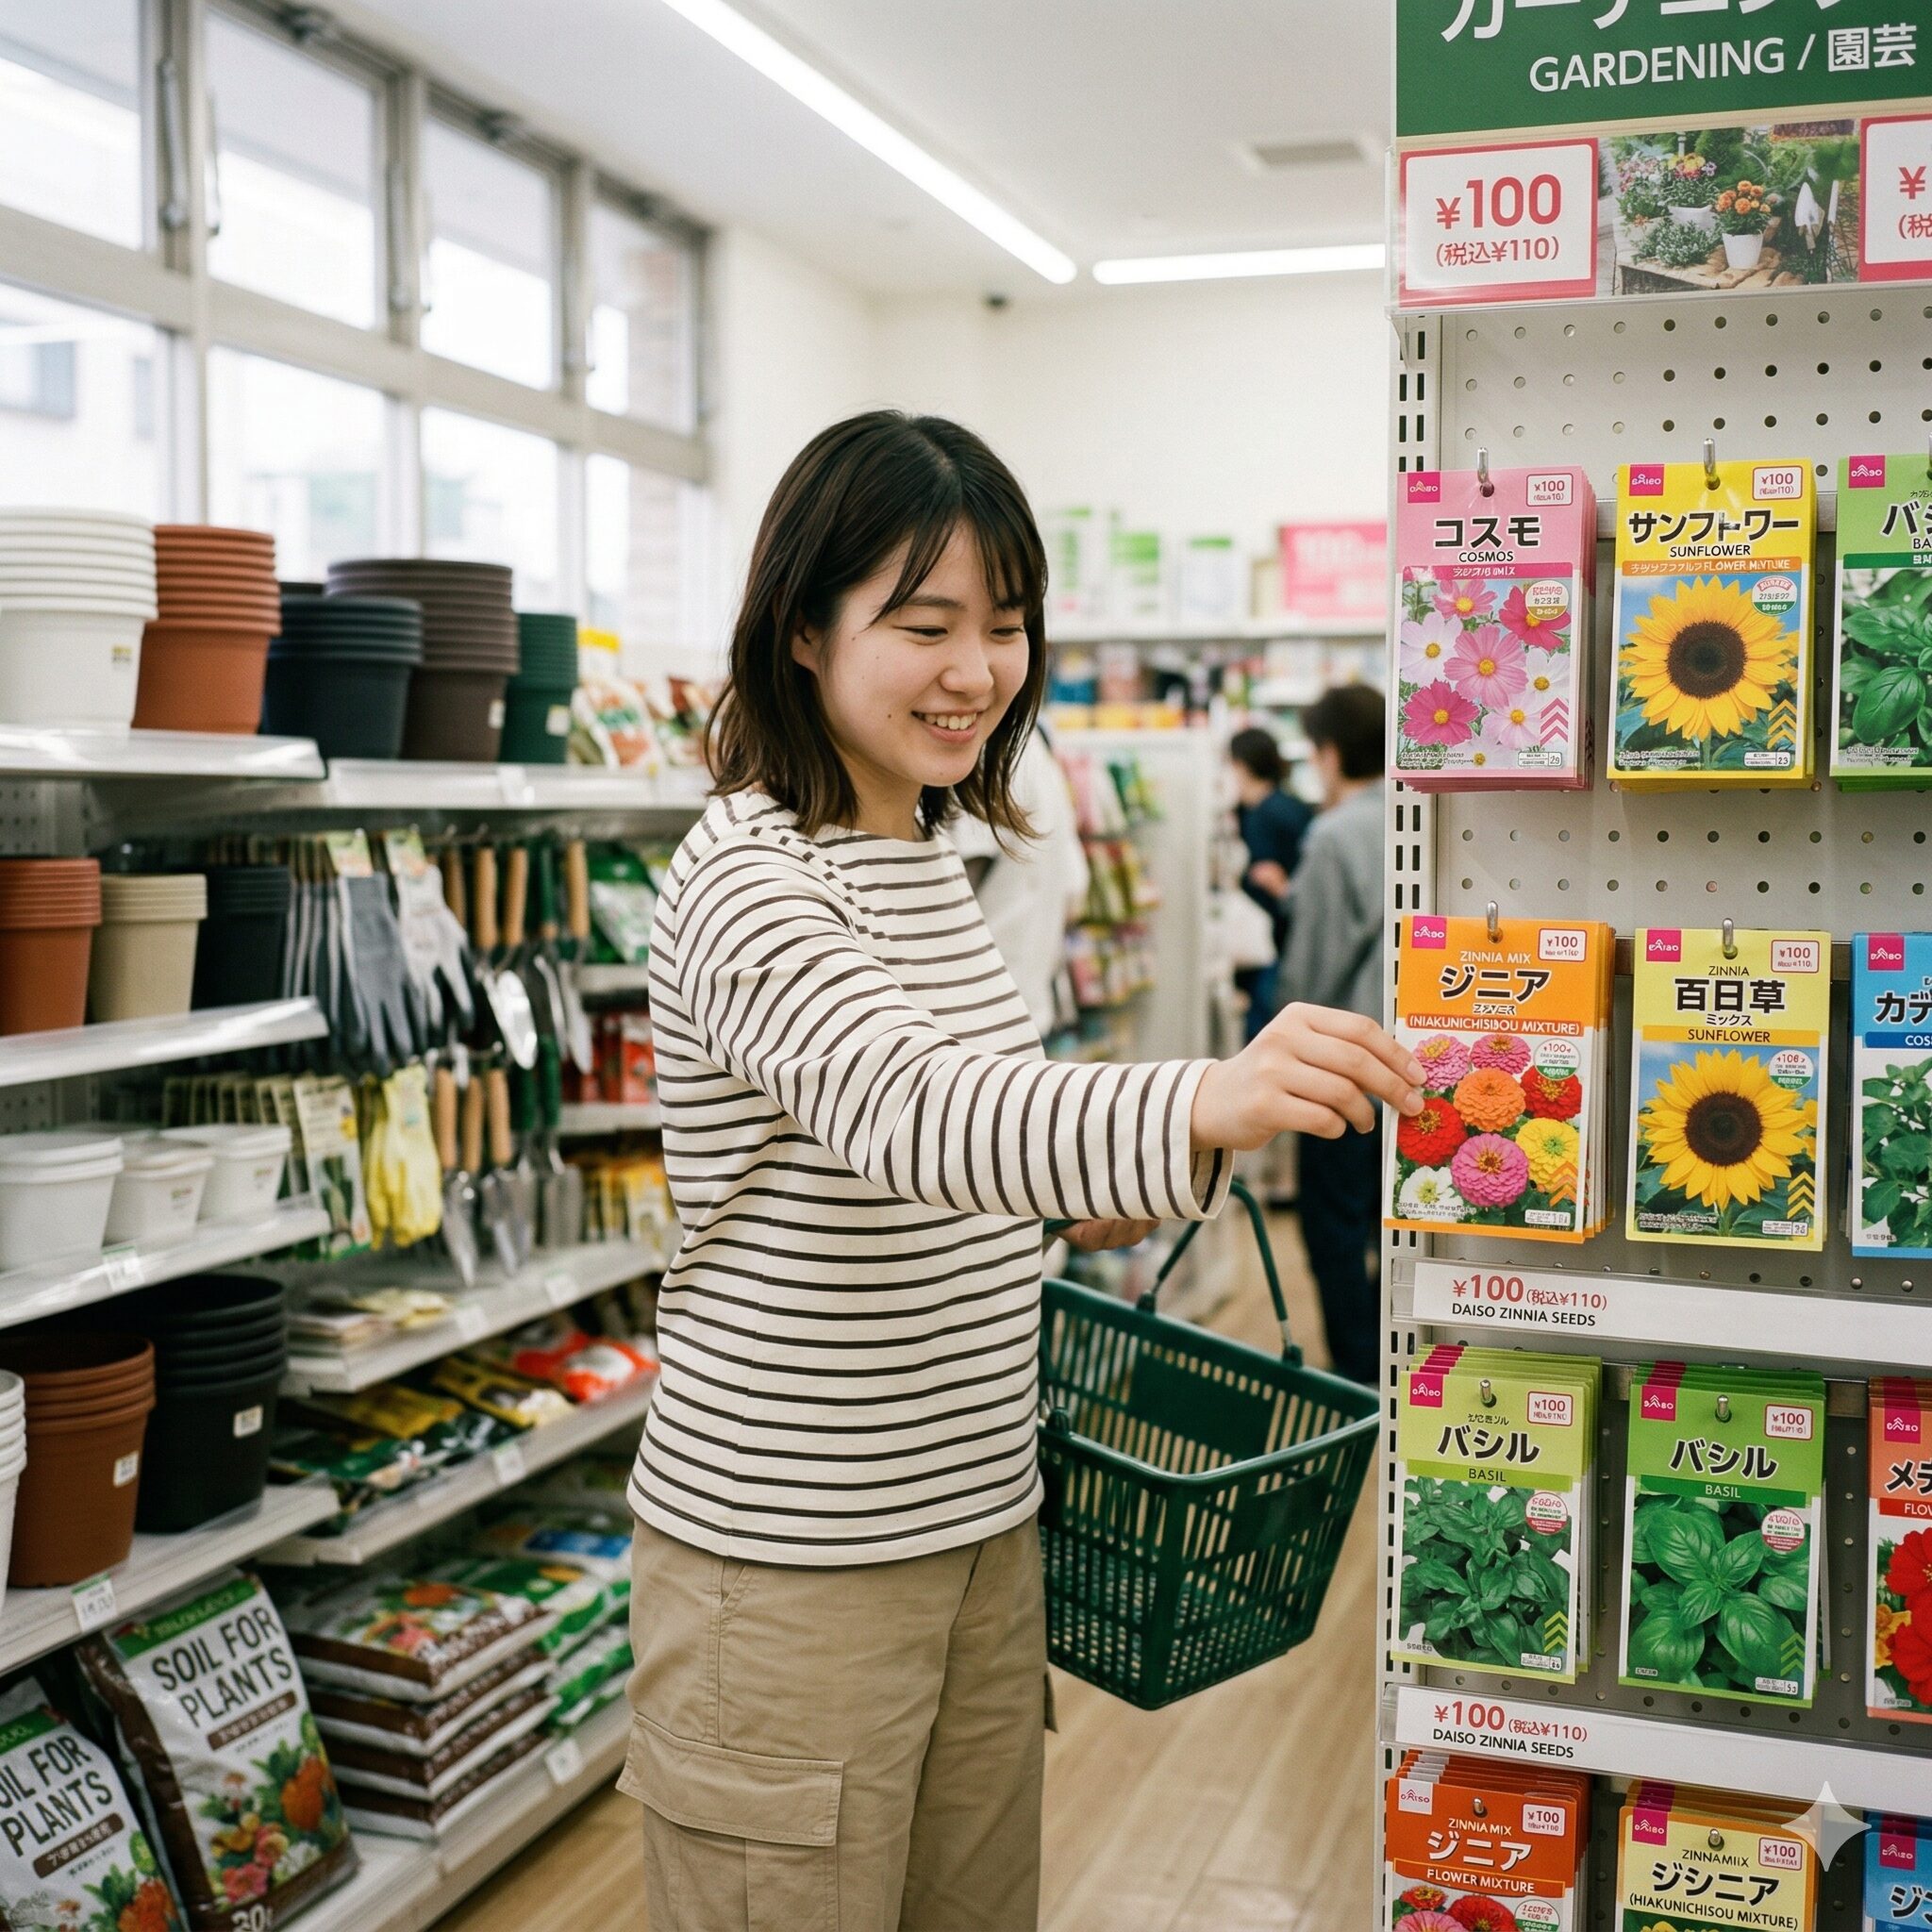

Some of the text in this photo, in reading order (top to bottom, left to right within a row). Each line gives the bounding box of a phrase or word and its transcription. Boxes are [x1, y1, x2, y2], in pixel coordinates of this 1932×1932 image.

[1529, 37, 1785, 92] GARDENING
[1828, 23, 1917, 72] 園芸
[1436, 174, 1562, 229] ¥100
[1436, 236, 1559, 267] (税込¥110)
[1435, 516, 1541, 548] コスモ
[1458, 551, 1514, 562] COSMOS
[1670, 544, 1751, 558] SUNFLOWER
[1459, 951, 1504, 962] ZINNIA
[1507, 953, 1531, 964] MIX
[1708, 965, 1750, 976] ZINNIA
[1441, 965, 1551, 1002] ジニア
[1674, 978, 1786, 1014] 百日草
[1522, 1020, 1579, 1035] MIXTURE)
[1706, 1013, 1753, 1025] ミックス
[1688, 1028, 1771, 1042] SUNFLOWER
[1906, 1035, 1932, 1046] COS
[1453, 1274, 1524, 1302] ¥100
[1451, 1303, 1596, 1326] DAISO ZINNIA SEEDS
[1436, 1424, 1541, 1464] バシル
[1670, 1438, 1778, 1480] バシル
[1469, 1468, 1507, 1482] BASIL
[1706, 1484, 1741, 1498] BASIL
[152, 1637, 224, 1691] SOIL
[220, 1607, 281, 1658] FOR
[179, 1646, 292, 1728] PLANTS
[1434, 1700, 1506, 1731] ¥100
[1433, 1728, 1574, 1758] DAISO ZINNIA SEEDS
[27, 1734, 92, 1788] FOR
[0, 1770, 113, 1858] PLANTS
[1448, 1817, 1489, 1833] ZINNIA
[1490, 1824, 1512, 1836] MIX
[1427, 1831, 1533, 1872] ジニア
[1763, 1844, 1796, 1858] ¥100
[1426, 1867, 1536, 1893] FLOWER MIXTURE
[1652, 1861, 1780, 1907] ジシニア
[1629, 1892, 1799, 1929] (HIAKUNICHISOU MIXTURE)
